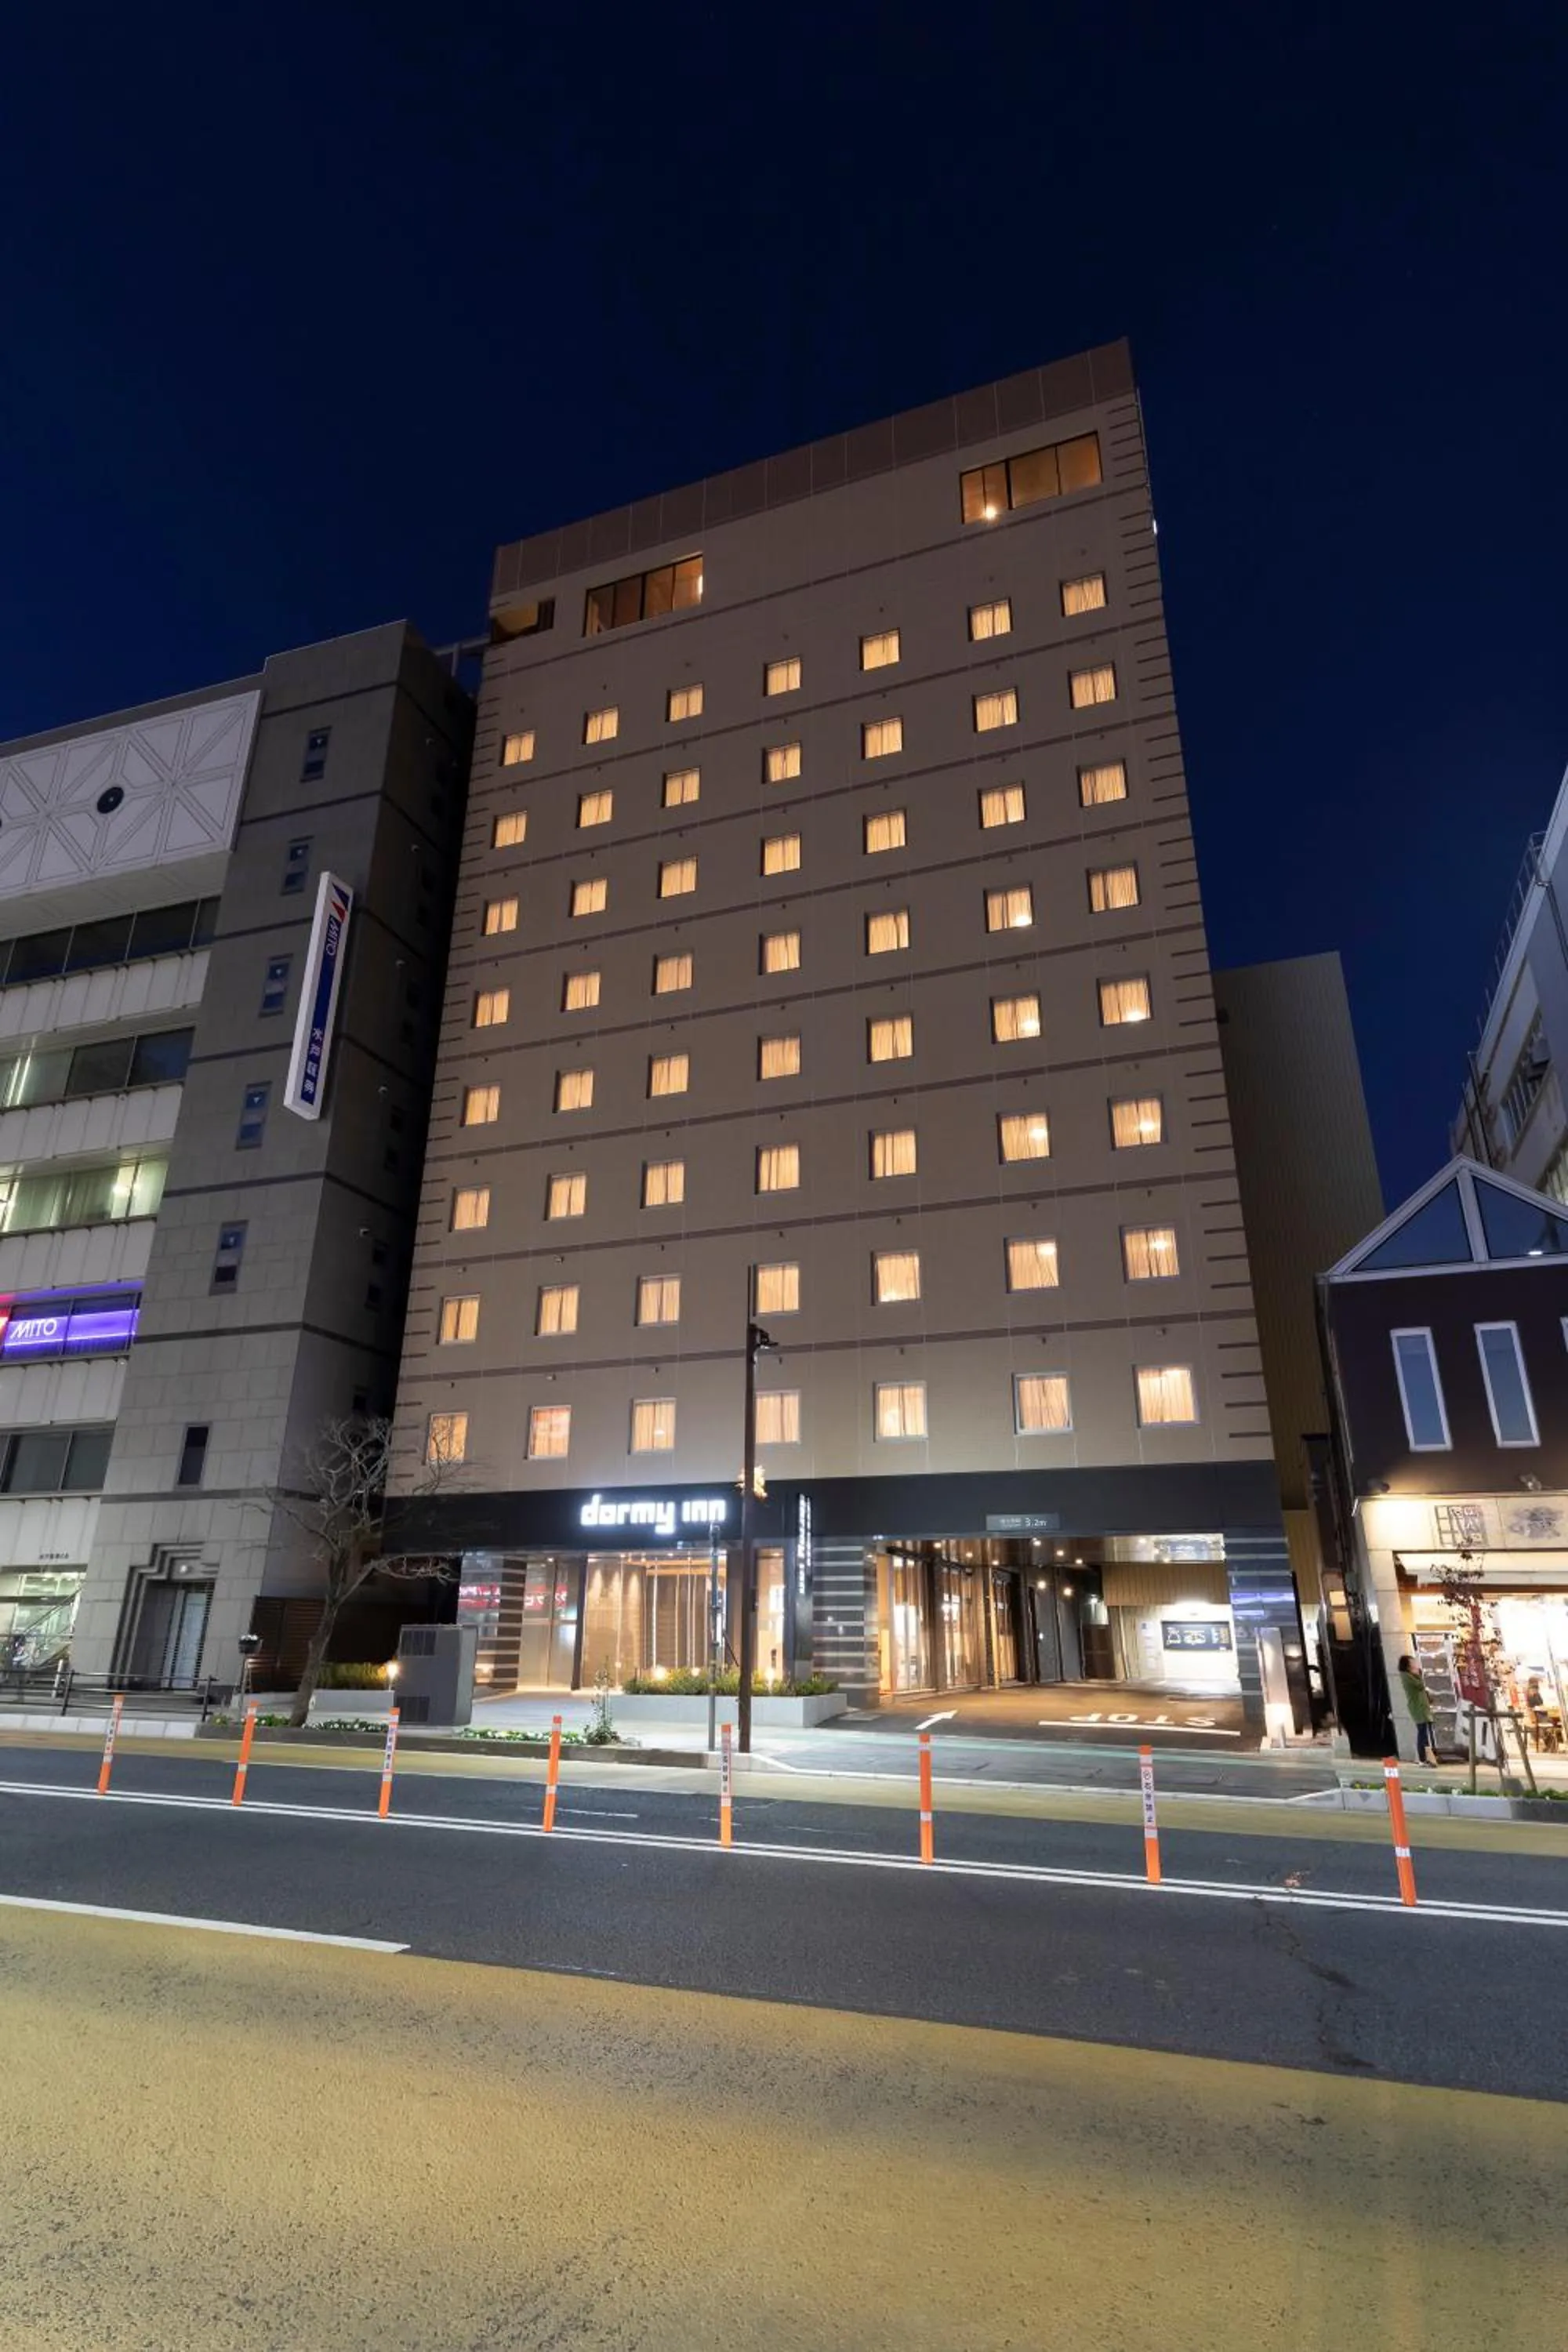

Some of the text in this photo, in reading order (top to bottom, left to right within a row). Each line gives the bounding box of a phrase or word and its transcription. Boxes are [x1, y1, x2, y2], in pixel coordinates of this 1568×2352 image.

[9, 1318, 57, 1340] MITO
[580, 1494, 726, 1535] dormy inn
[1069, 1712, 1216, 1727] STOP
